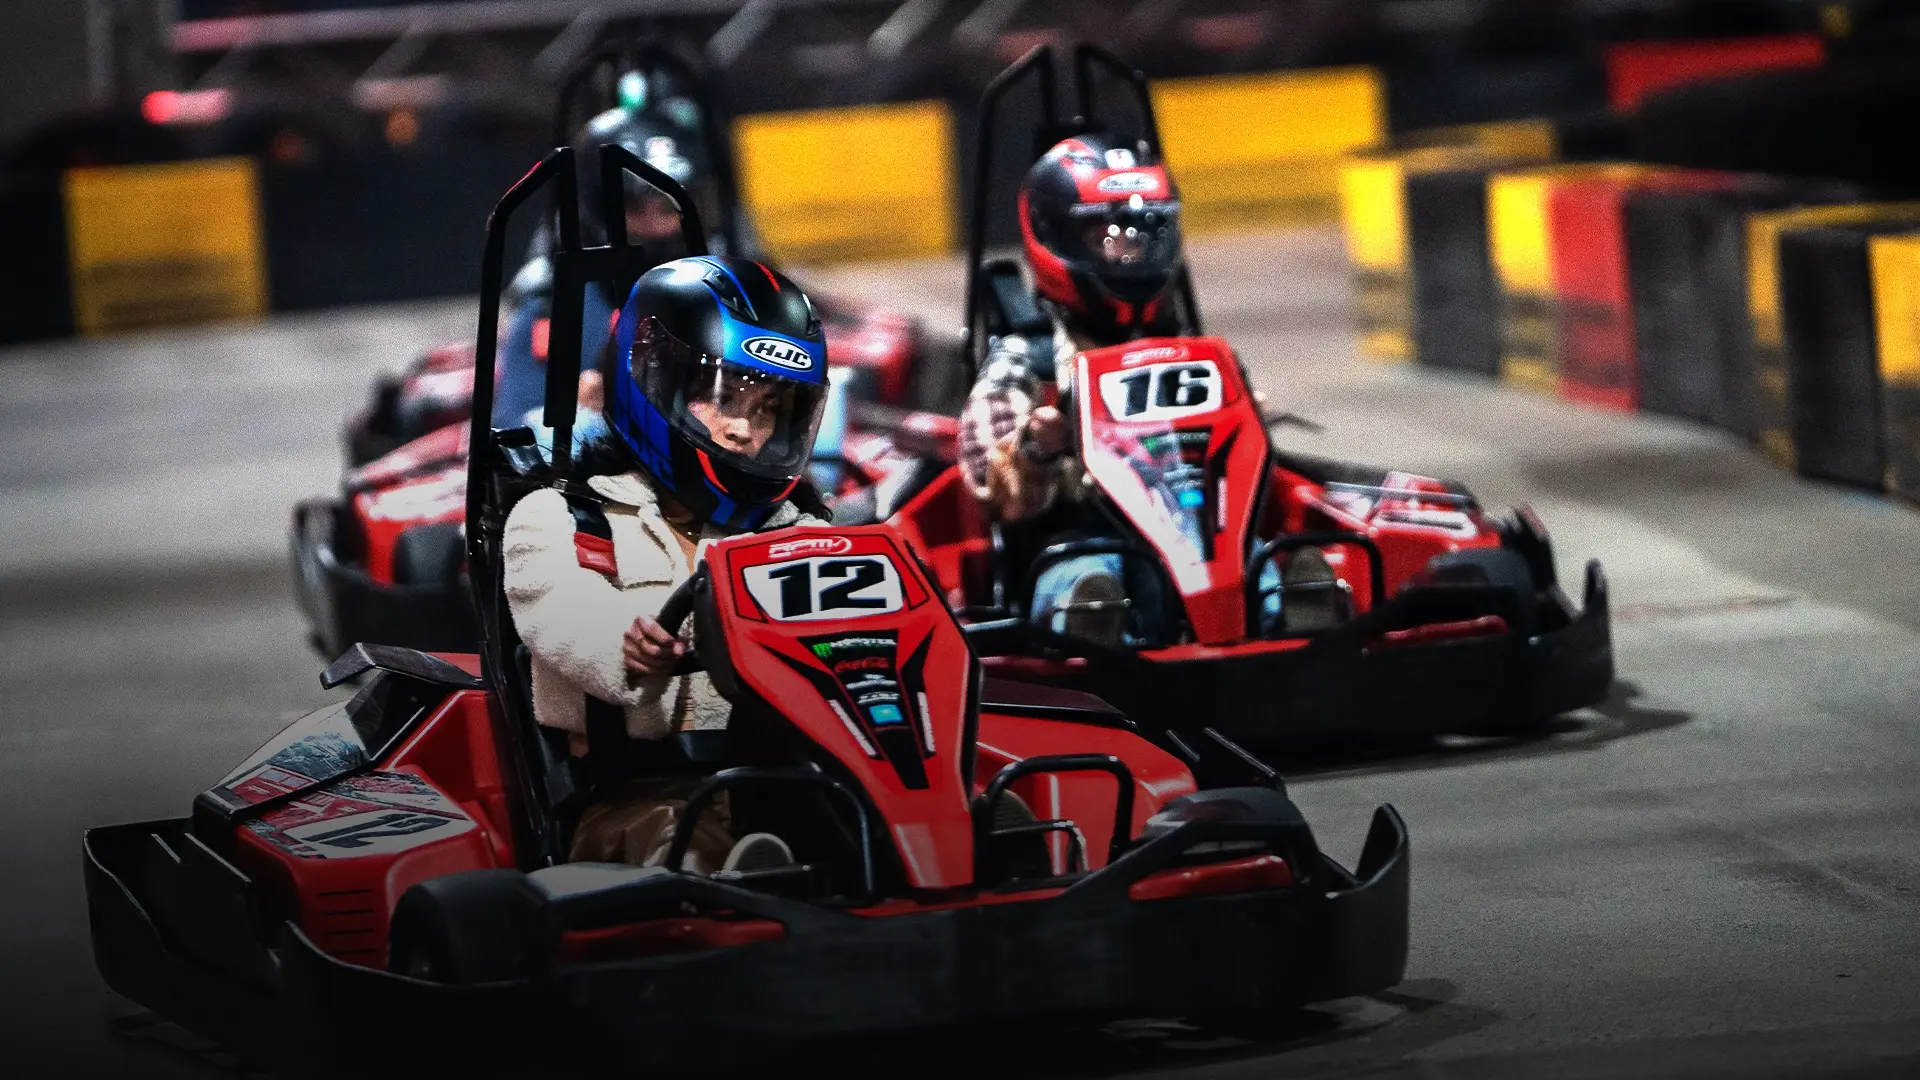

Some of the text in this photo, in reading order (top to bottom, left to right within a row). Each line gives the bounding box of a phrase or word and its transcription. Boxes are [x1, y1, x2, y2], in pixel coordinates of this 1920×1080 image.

[754, 342, 809, 366] HJC
[1119, 363, 1211, 416] 16
[768, 558, 888, 619] 12
[301, 813, 451, 849] 12
